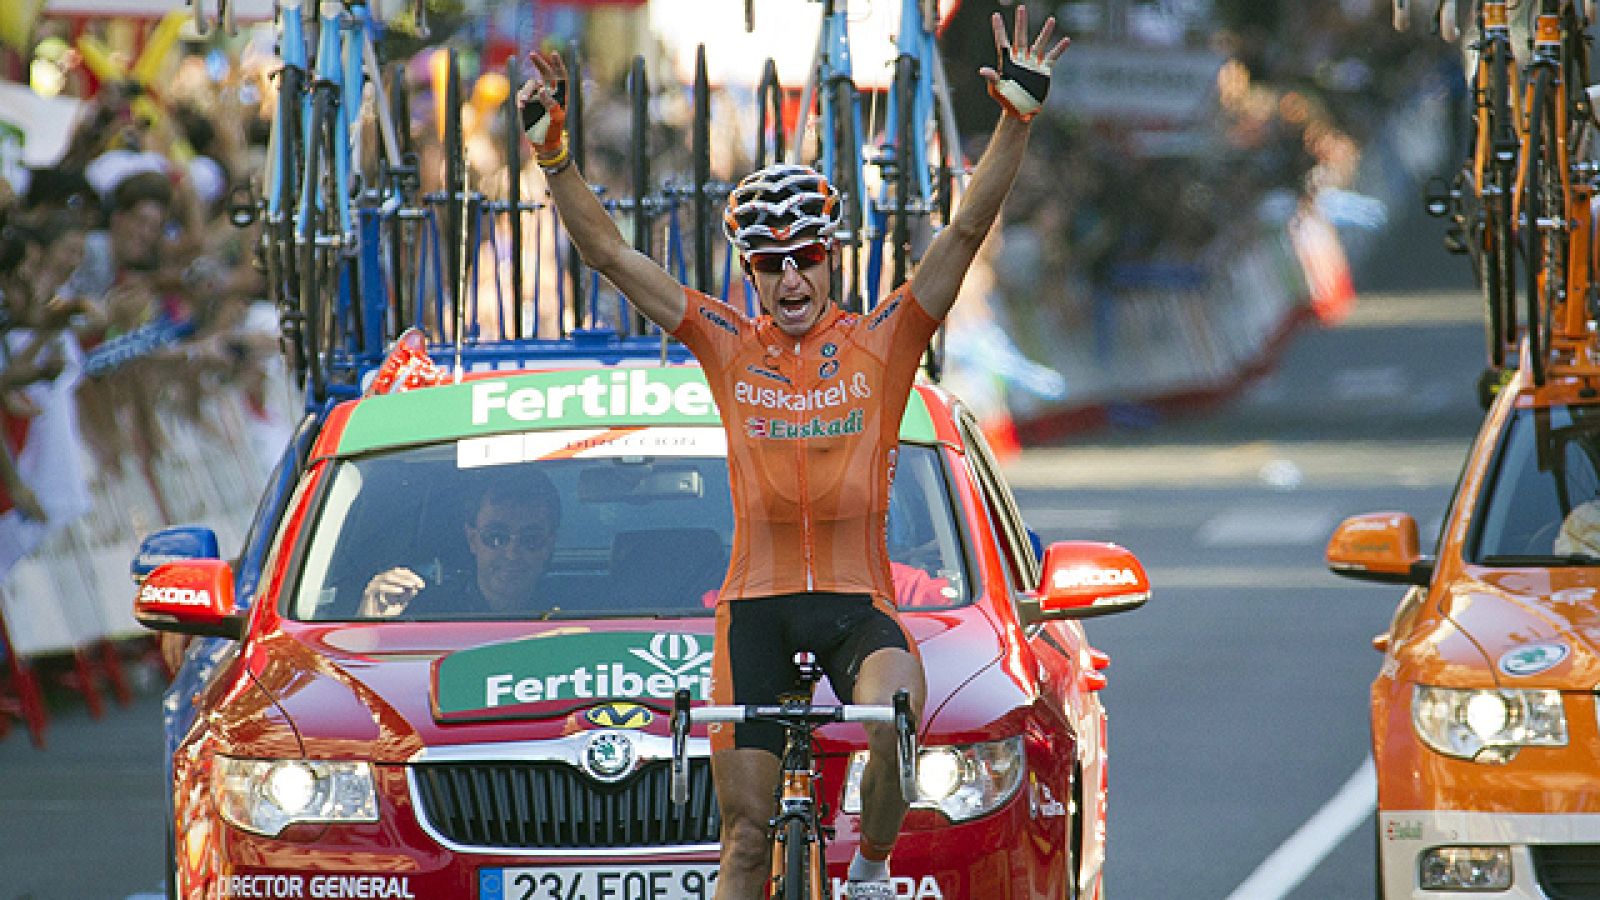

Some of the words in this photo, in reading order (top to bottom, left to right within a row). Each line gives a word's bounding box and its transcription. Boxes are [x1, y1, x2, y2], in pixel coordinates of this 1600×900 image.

[472, 369, 719, 426] Fertibe
[769, 409, 864, 439] Euskadi
[218, 874, 304, 898] DIRECTOR
[309, 875, 415, 899] GENERAL
[681, 870, 719, 900] 9
